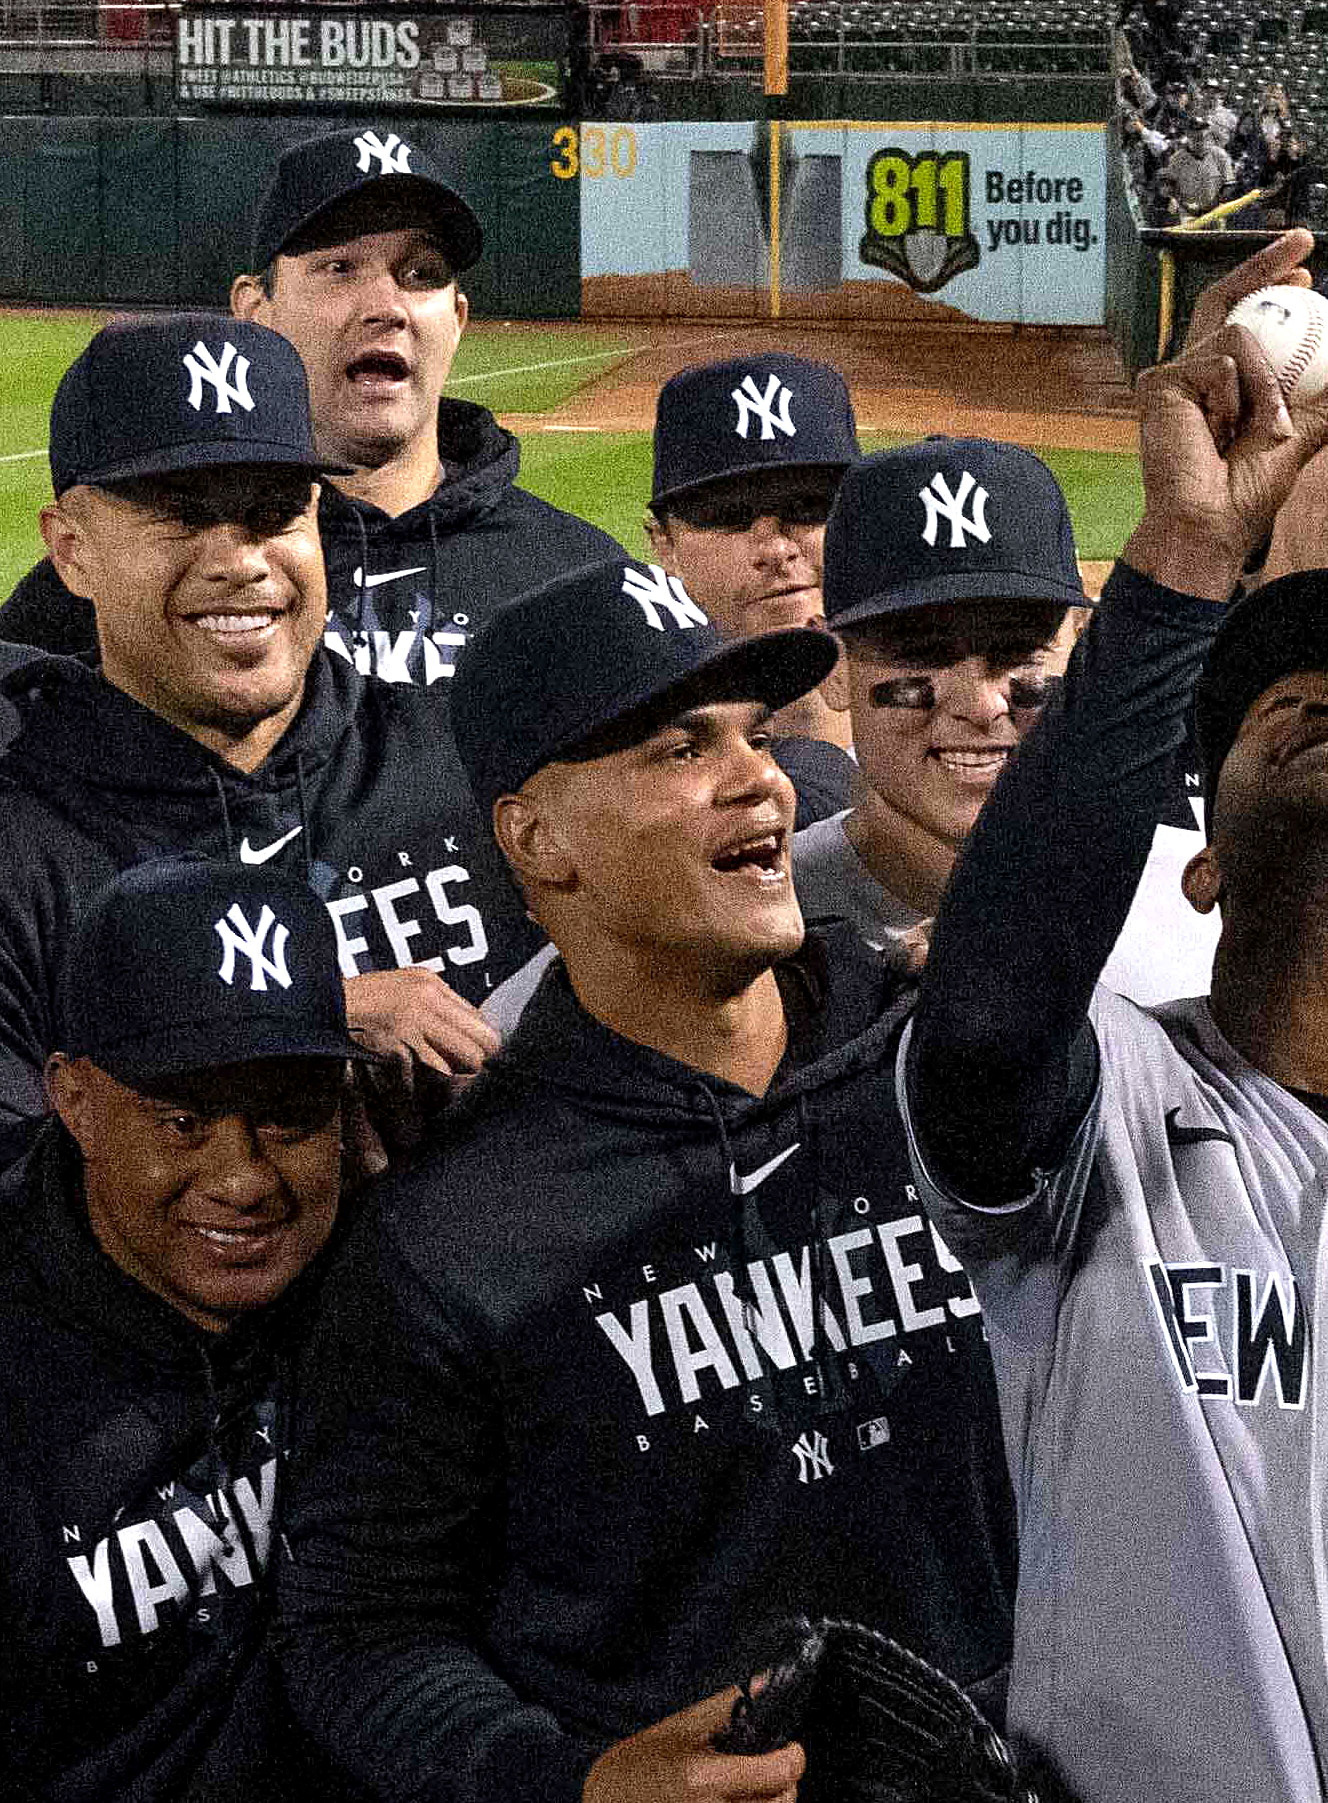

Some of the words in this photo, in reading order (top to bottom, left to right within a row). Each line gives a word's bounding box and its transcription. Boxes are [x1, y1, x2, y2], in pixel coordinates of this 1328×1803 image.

[179, 19, 235, 65] HIT
[242, 20, 310, 66] THE
[321, 21, 419, 68] BUDS
[354, 131, 411, 174] NY
[552, 126, 636, 179] 330
[868, 150, 968, 237] 811
[985, 171, 1083, 203] Before
[987, 219, 1040, 251] you
[1046, 212, 1097, 251] dig.
[183, 341, 255, 413] NY
[732, 374, 796, 439] NY
[919, 471, 991, 547] NY
[348, 836, 459, 883] ORK
[215, 904, 292, 990] NY
